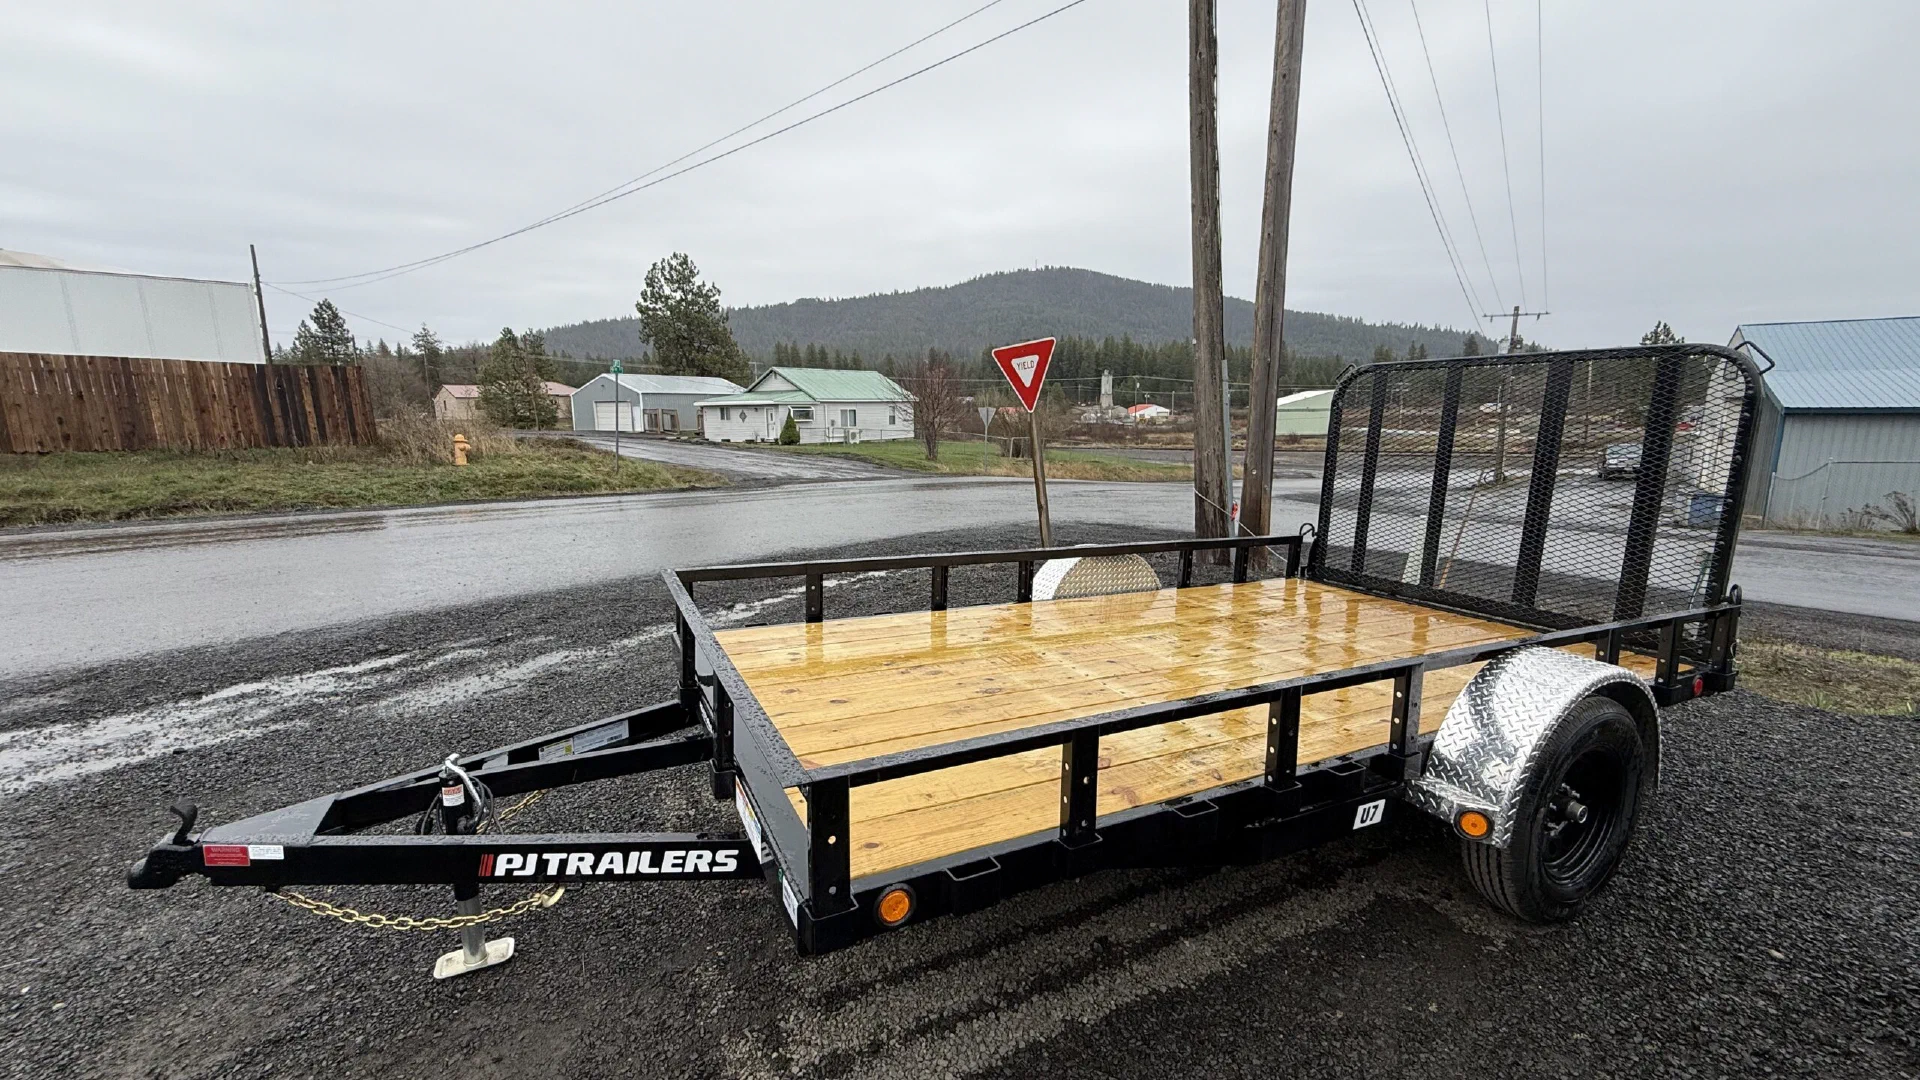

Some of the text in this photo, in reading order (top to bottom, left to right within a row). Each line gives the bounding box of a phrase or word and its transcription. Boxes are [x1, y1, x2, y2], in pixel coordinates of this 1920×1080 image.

[1016, 360, 1035, 370] YIELD
[1360, 804, 1379, 824] U7
[494, 853, 538, 876] PJ
[542, 850, 739, 875] TRAILERS
